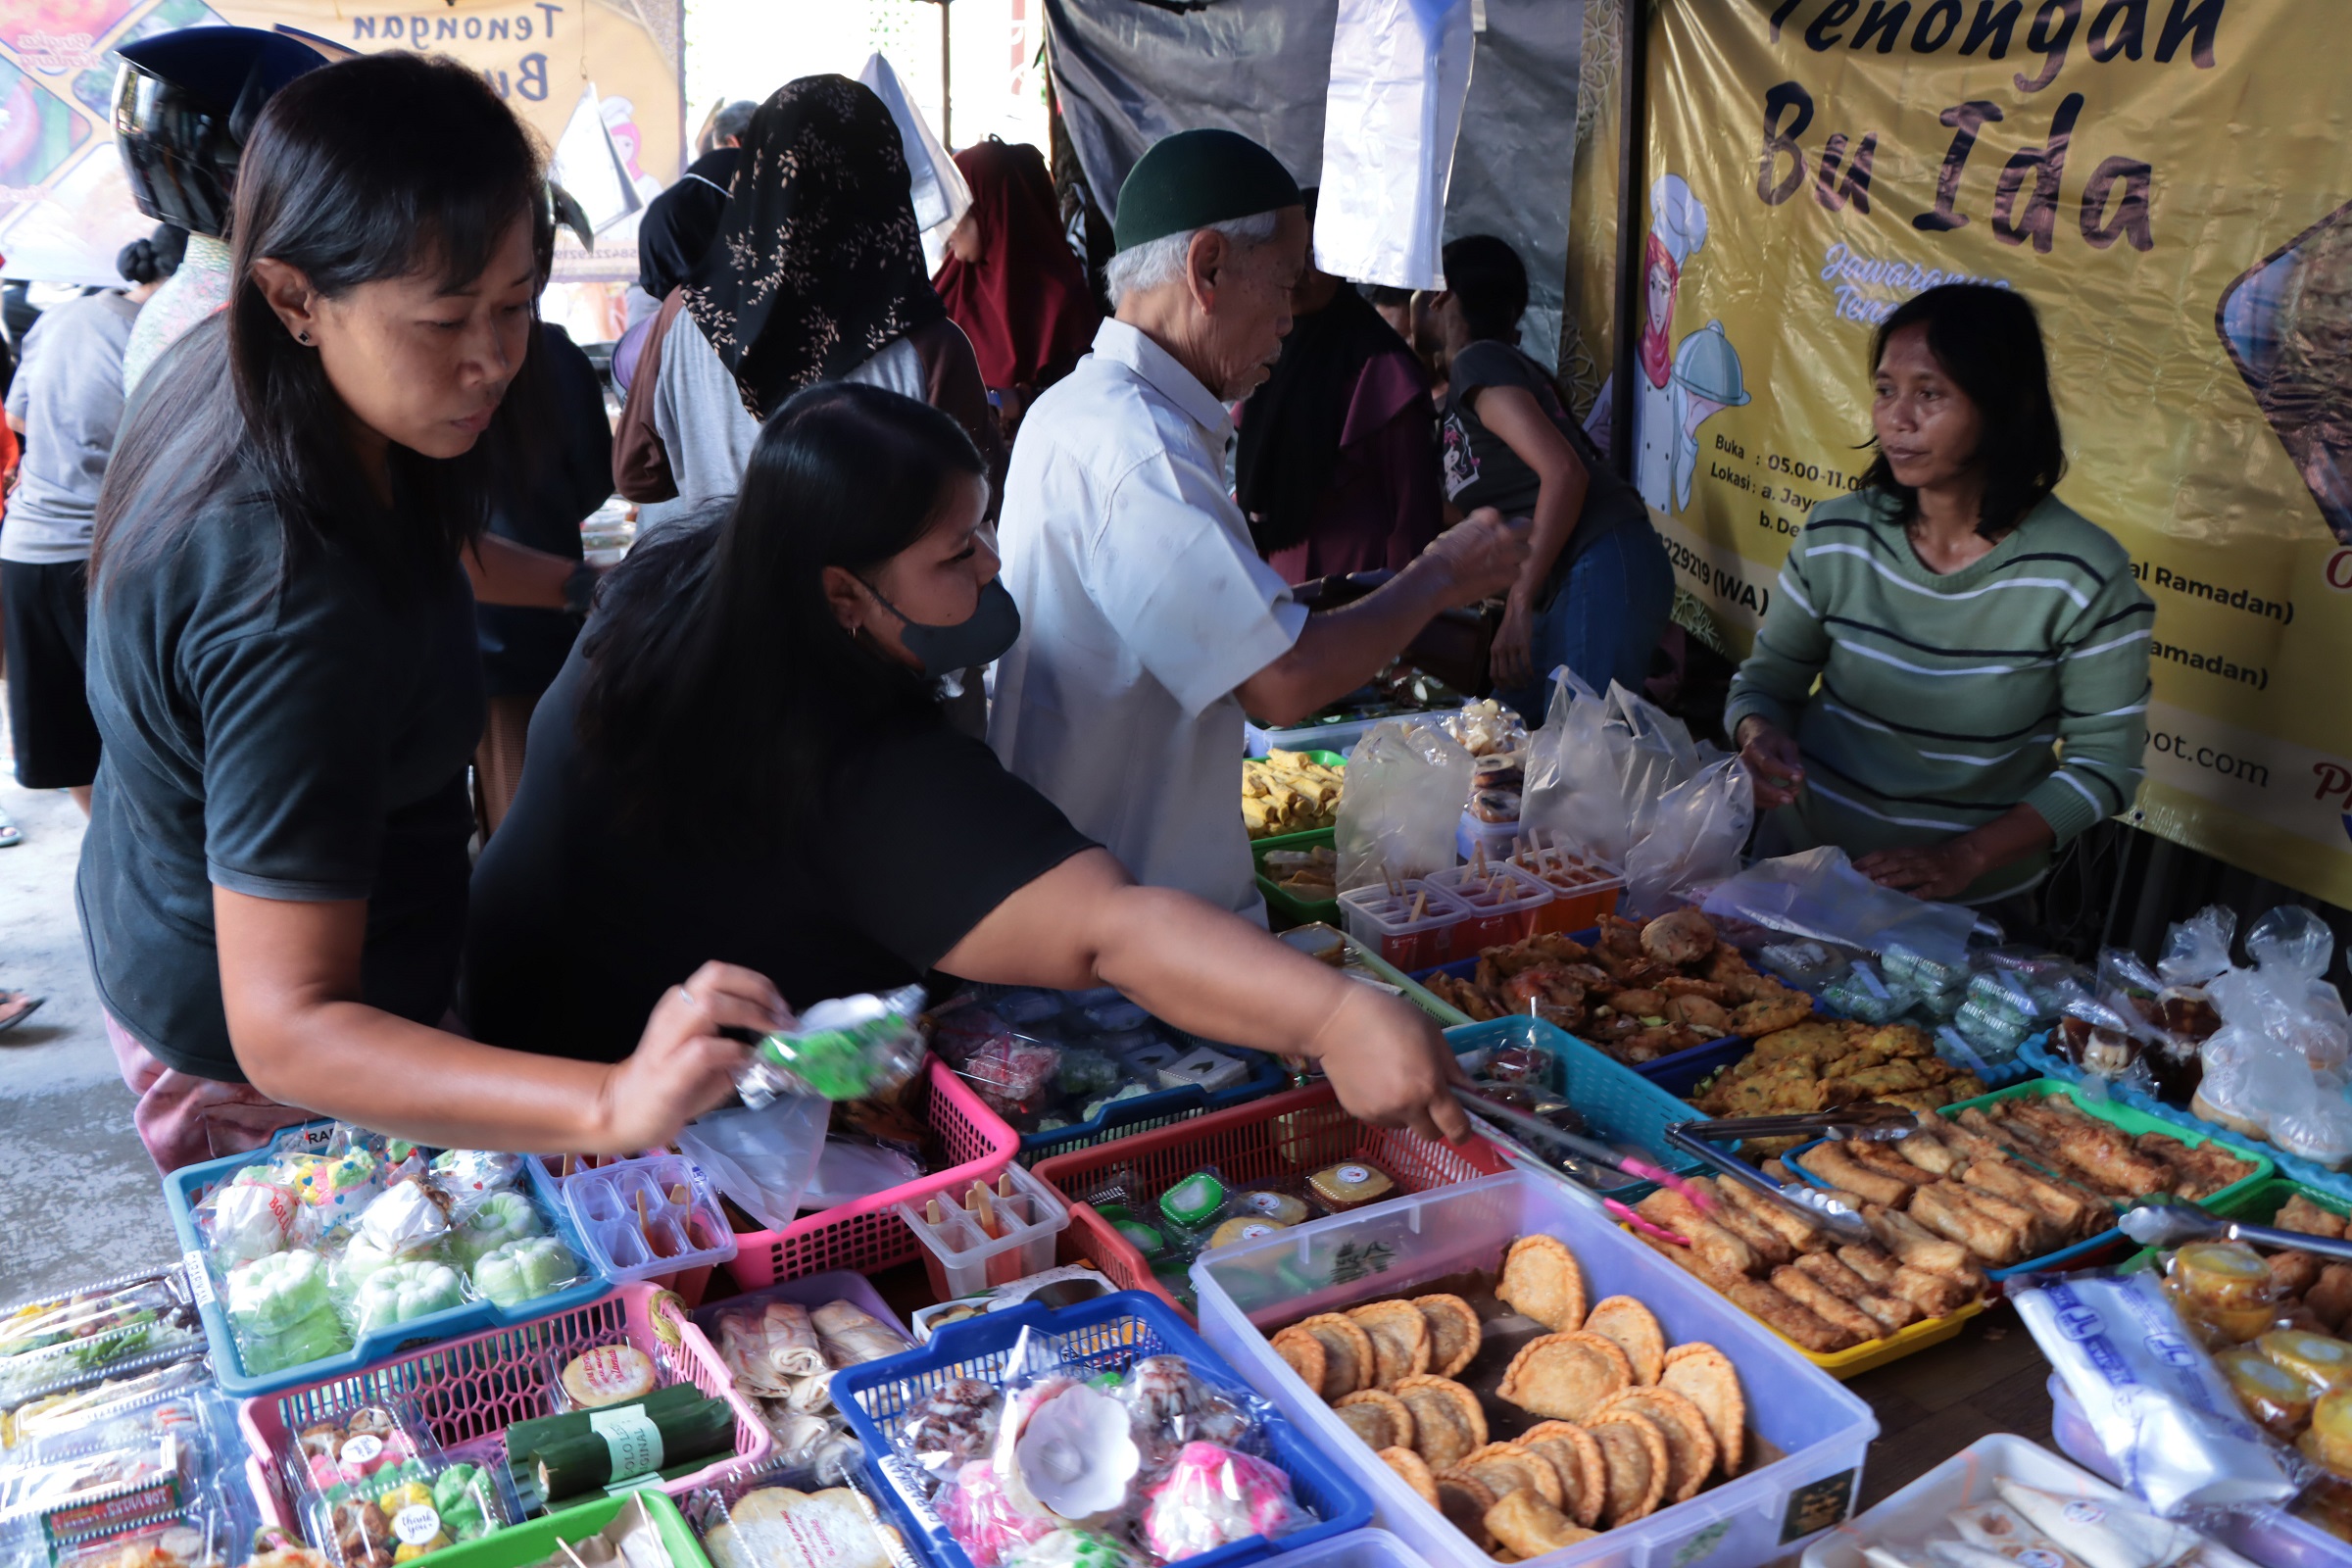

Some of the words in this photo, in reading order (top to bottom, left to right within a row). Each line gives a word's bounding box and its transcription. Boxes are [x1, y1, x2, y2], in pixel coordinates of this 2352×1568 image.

[1757, 81, 1878, 215] Bu
[1912, 92, 2154, 254] Ida
[1715, 434, 1744, 460] Buka
[1710, 462, 1750, 490] Lokasi
[1714, 568, 1769, 616] (WA)
[2155, 566, 2294, 625] Ramadan)
